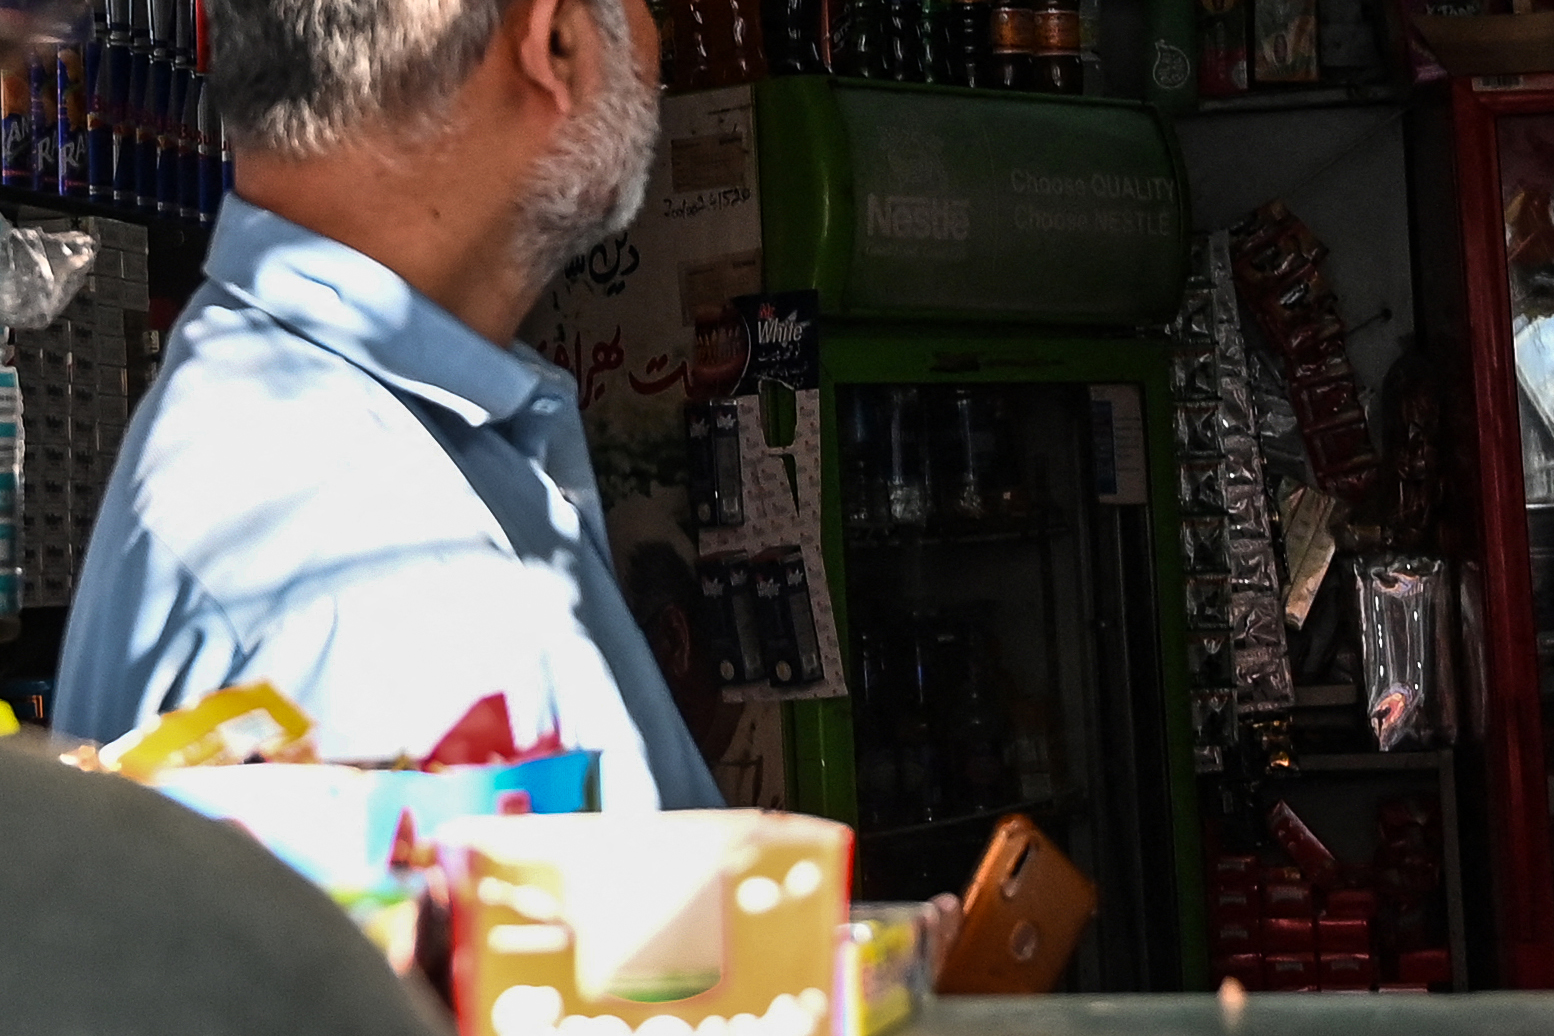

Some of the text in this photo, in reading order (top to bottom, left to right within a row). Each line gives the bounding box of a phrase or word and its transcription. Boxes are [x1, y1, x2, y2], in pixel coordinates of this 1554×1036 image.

[1010, 169, 1175, 203] Choose QUALITY
[1014, 206, 1085, 231] Choose
[757, 317, 803, 344] White
